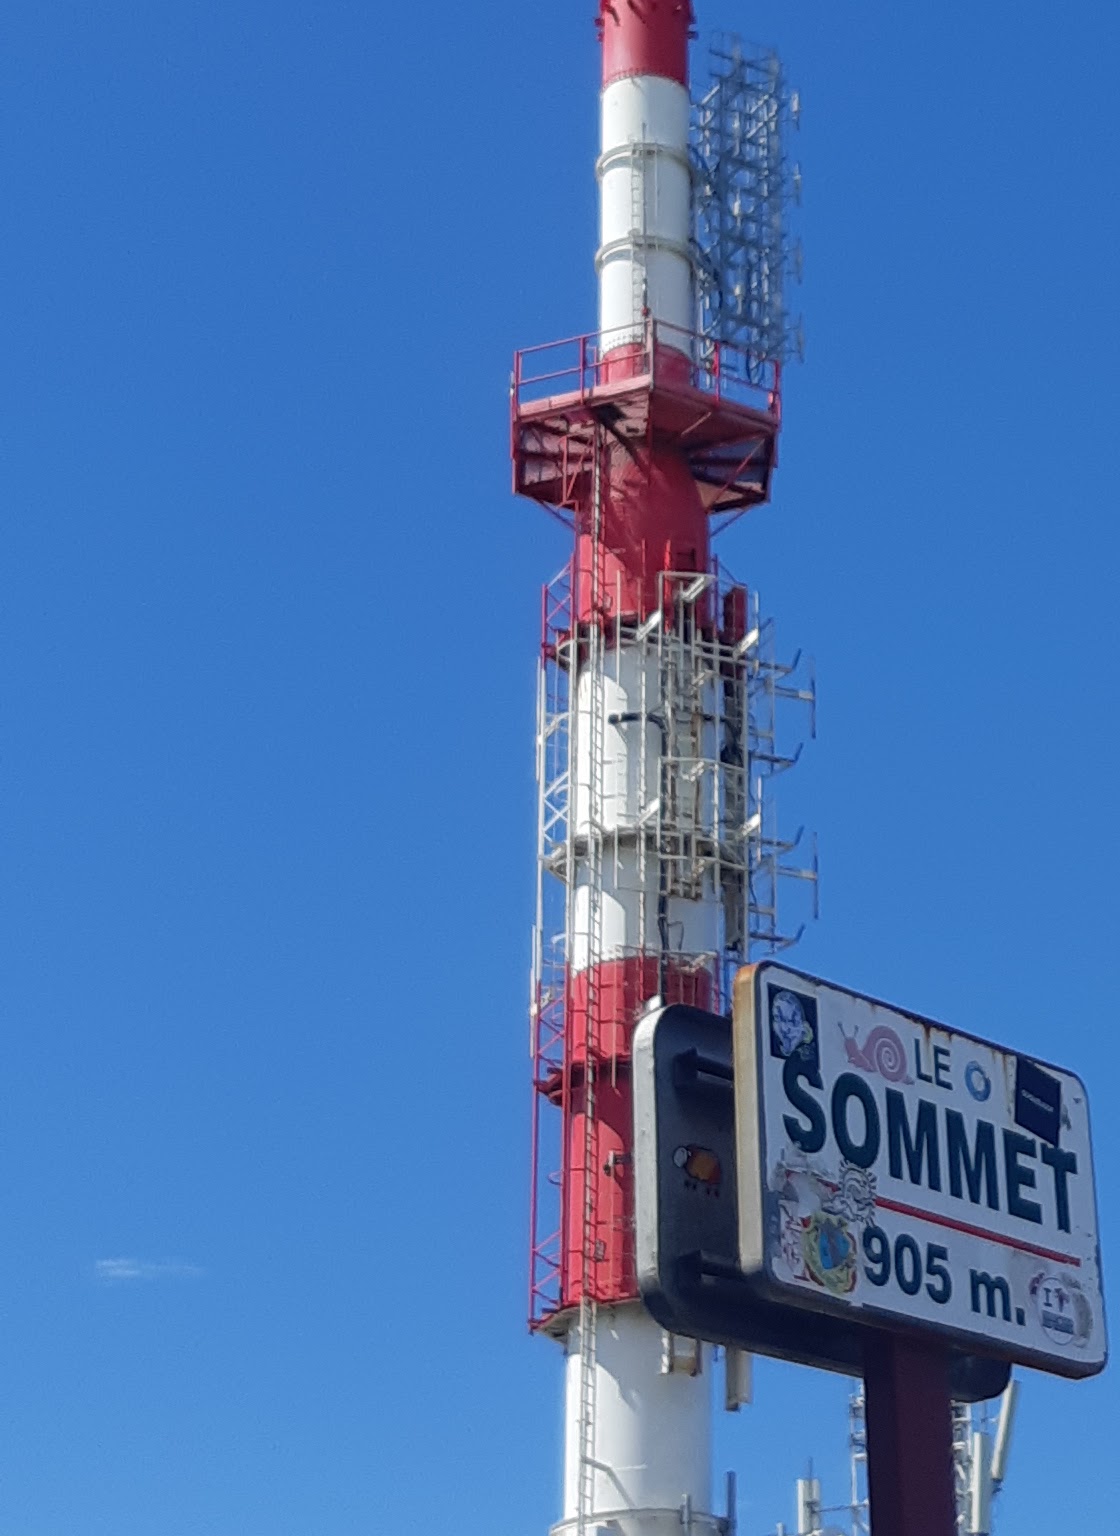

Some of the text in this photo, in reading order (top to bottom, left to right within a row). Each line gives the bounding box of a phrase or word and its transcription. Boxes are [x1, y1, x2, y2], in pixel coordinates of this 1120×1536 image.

[914, 1038, 954, 1091] LE
[782, 1047, 1078, 1235] SOMMET
[862, 1225, 1026, 1327] 905 m.
